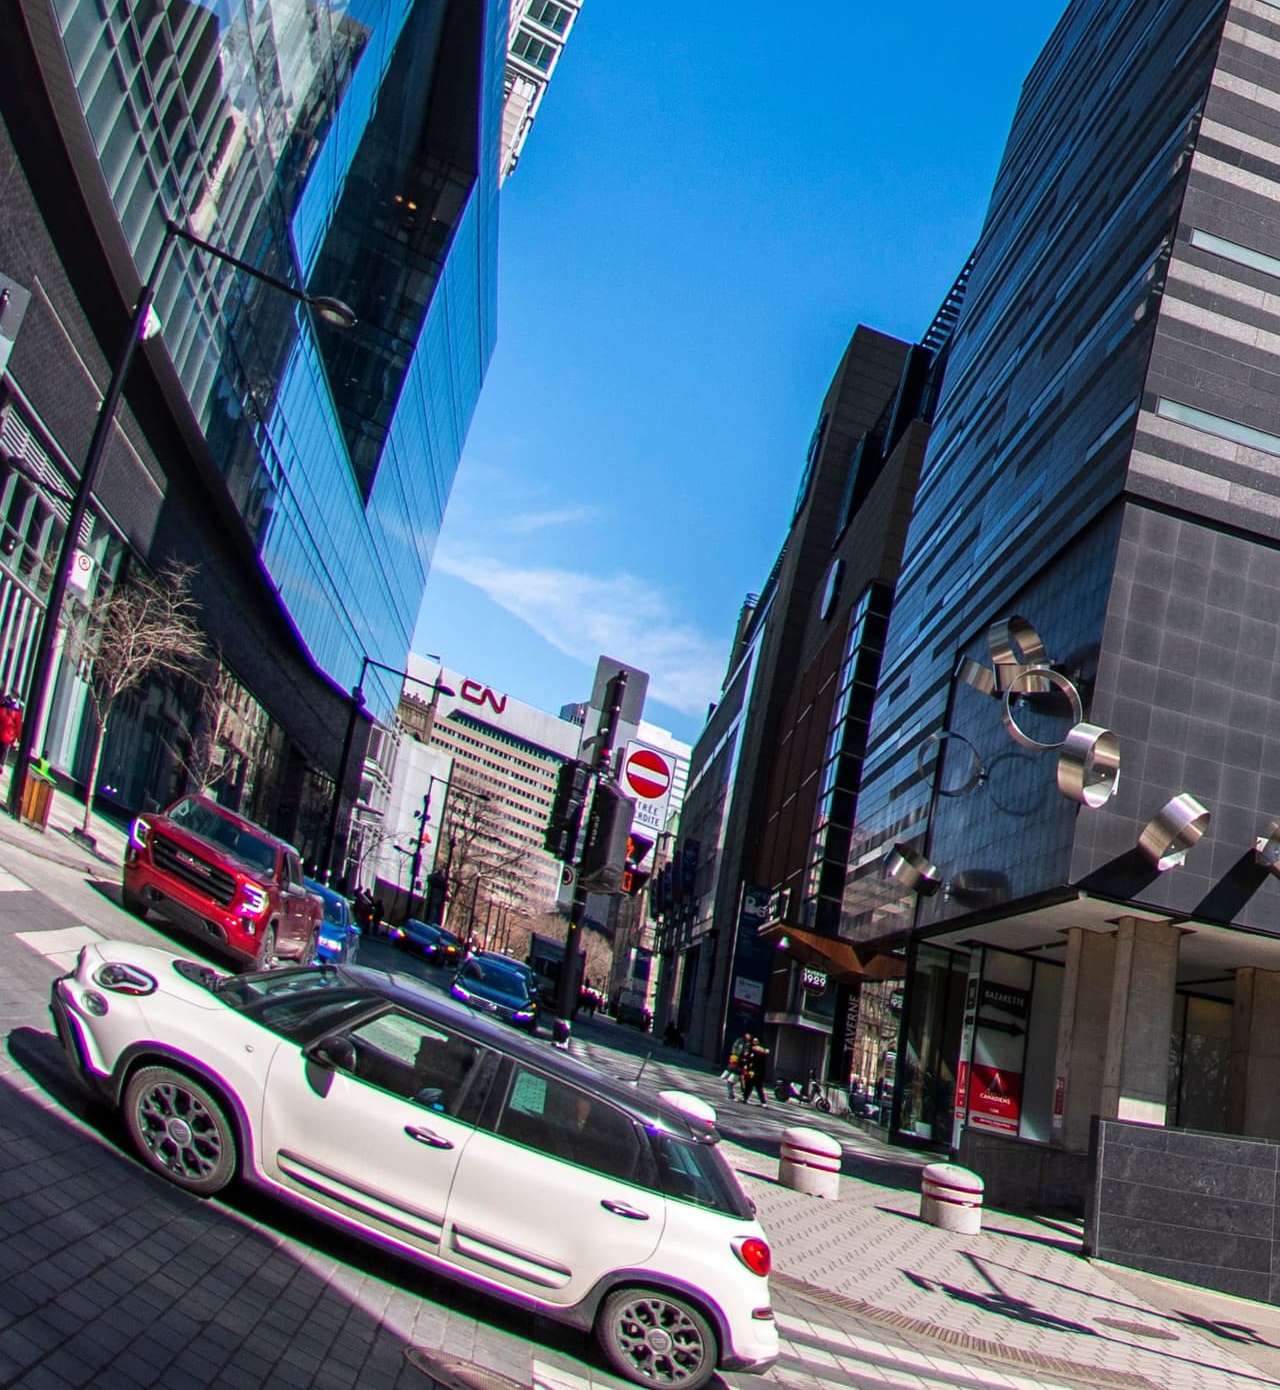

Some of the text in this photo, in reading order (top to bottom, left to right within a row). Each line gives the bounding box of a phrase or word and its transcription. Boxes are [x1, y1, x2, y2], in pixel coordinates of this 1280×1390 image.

[461, 680, 507, 714] CN
[637, 801, 659, 817] TRÉE
[803, 973, 827, 988] 1929
[843, 994, 860, 1051] TAVERNE
